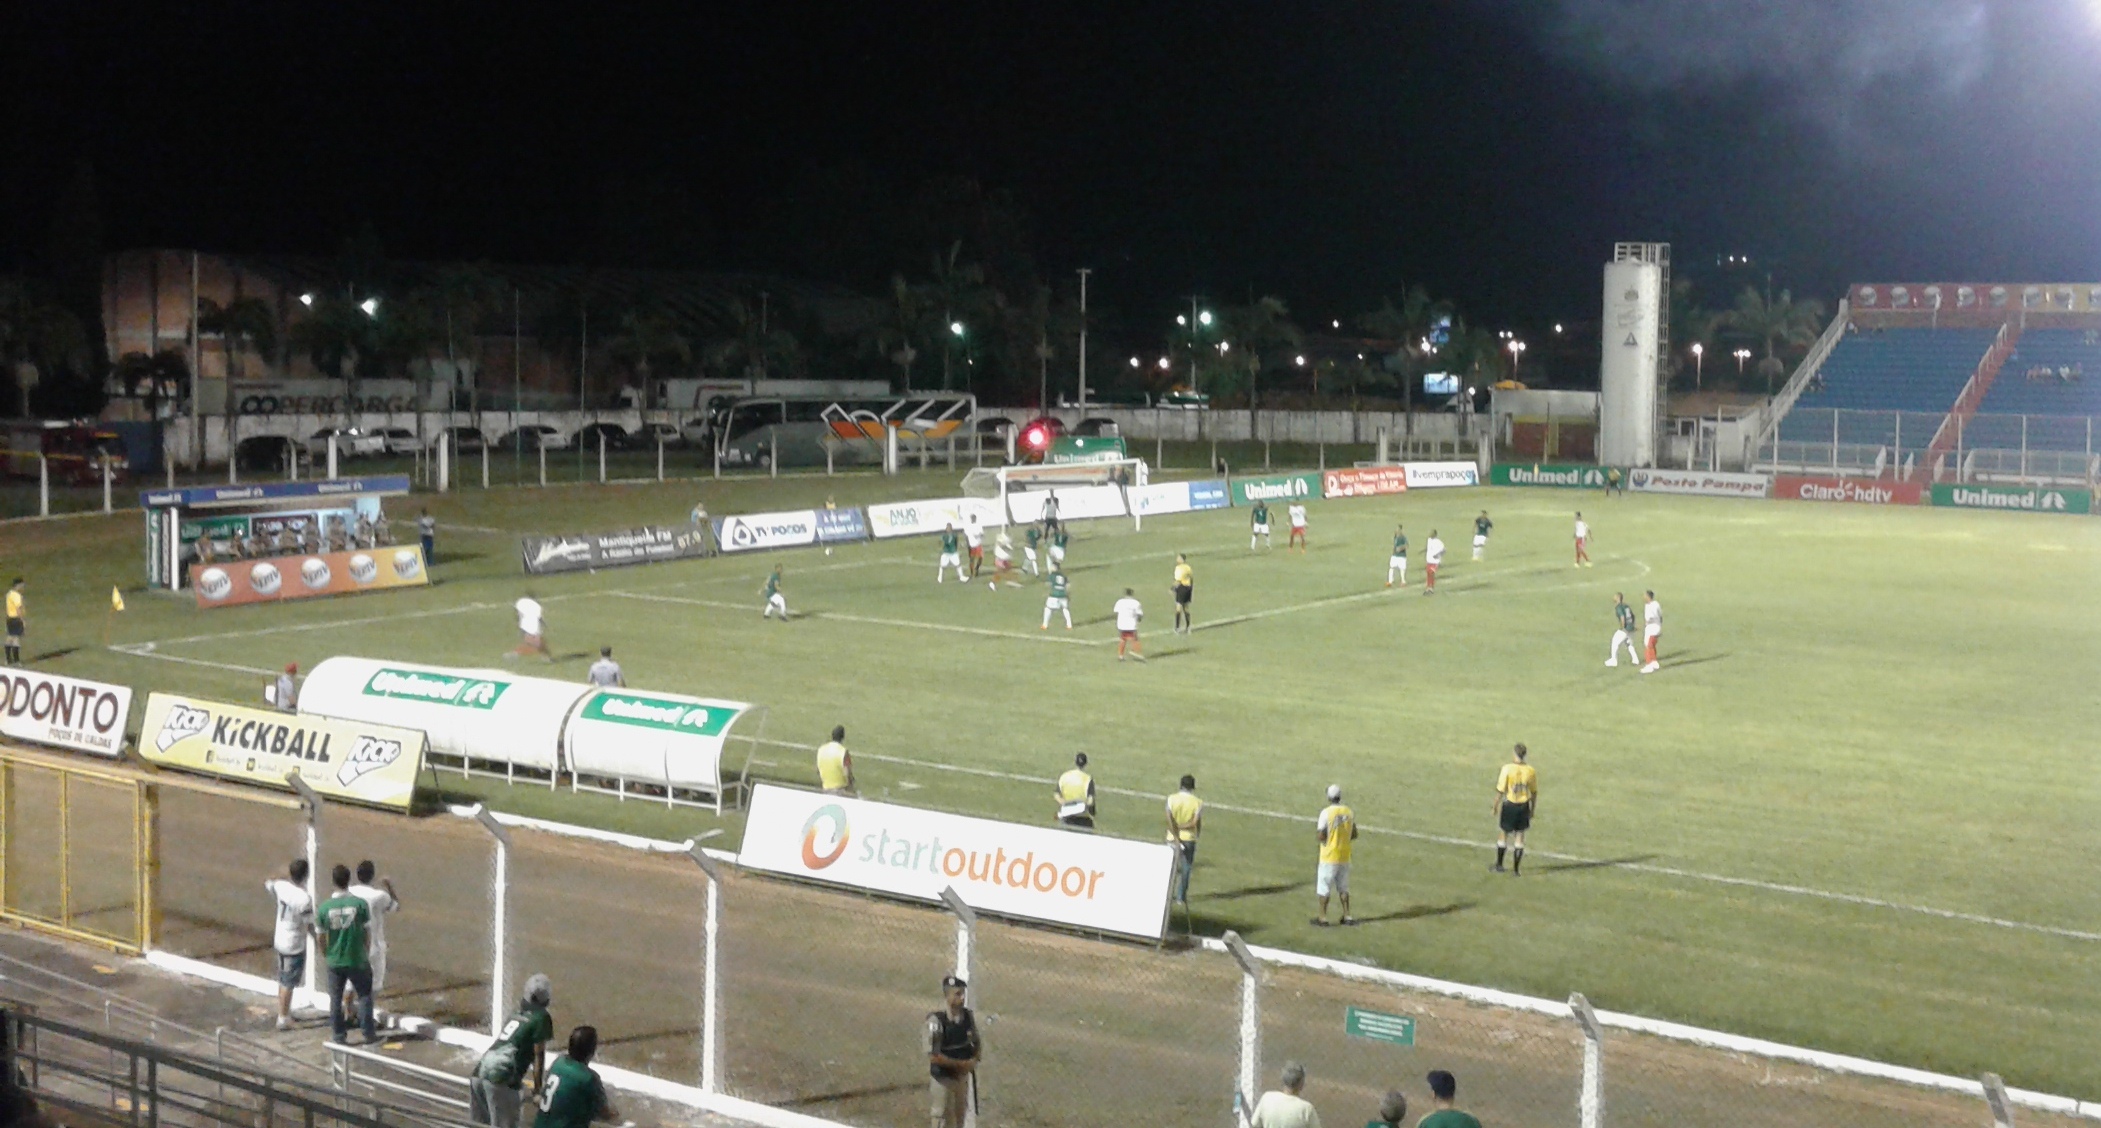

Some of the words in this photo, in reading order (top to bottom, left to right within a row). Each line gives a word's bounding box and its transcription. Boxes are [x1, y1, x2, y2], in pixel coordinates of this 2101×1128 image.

[1509, 467, 1579, 485] Unimed
[1651, 474, 1697, 488] Posto
[1702, 476, 1765, 493] Pampa
[1244, 477, 1293, 500] Unimed
[1952, 487, 2035, 509] Unimed
[371, 671, 466, 701] Unimed
[602, 697, 685, 724] Unimed
[858, 828, 1105, 900] startoutdoor
[499, 1019, 520, 1042] 9
